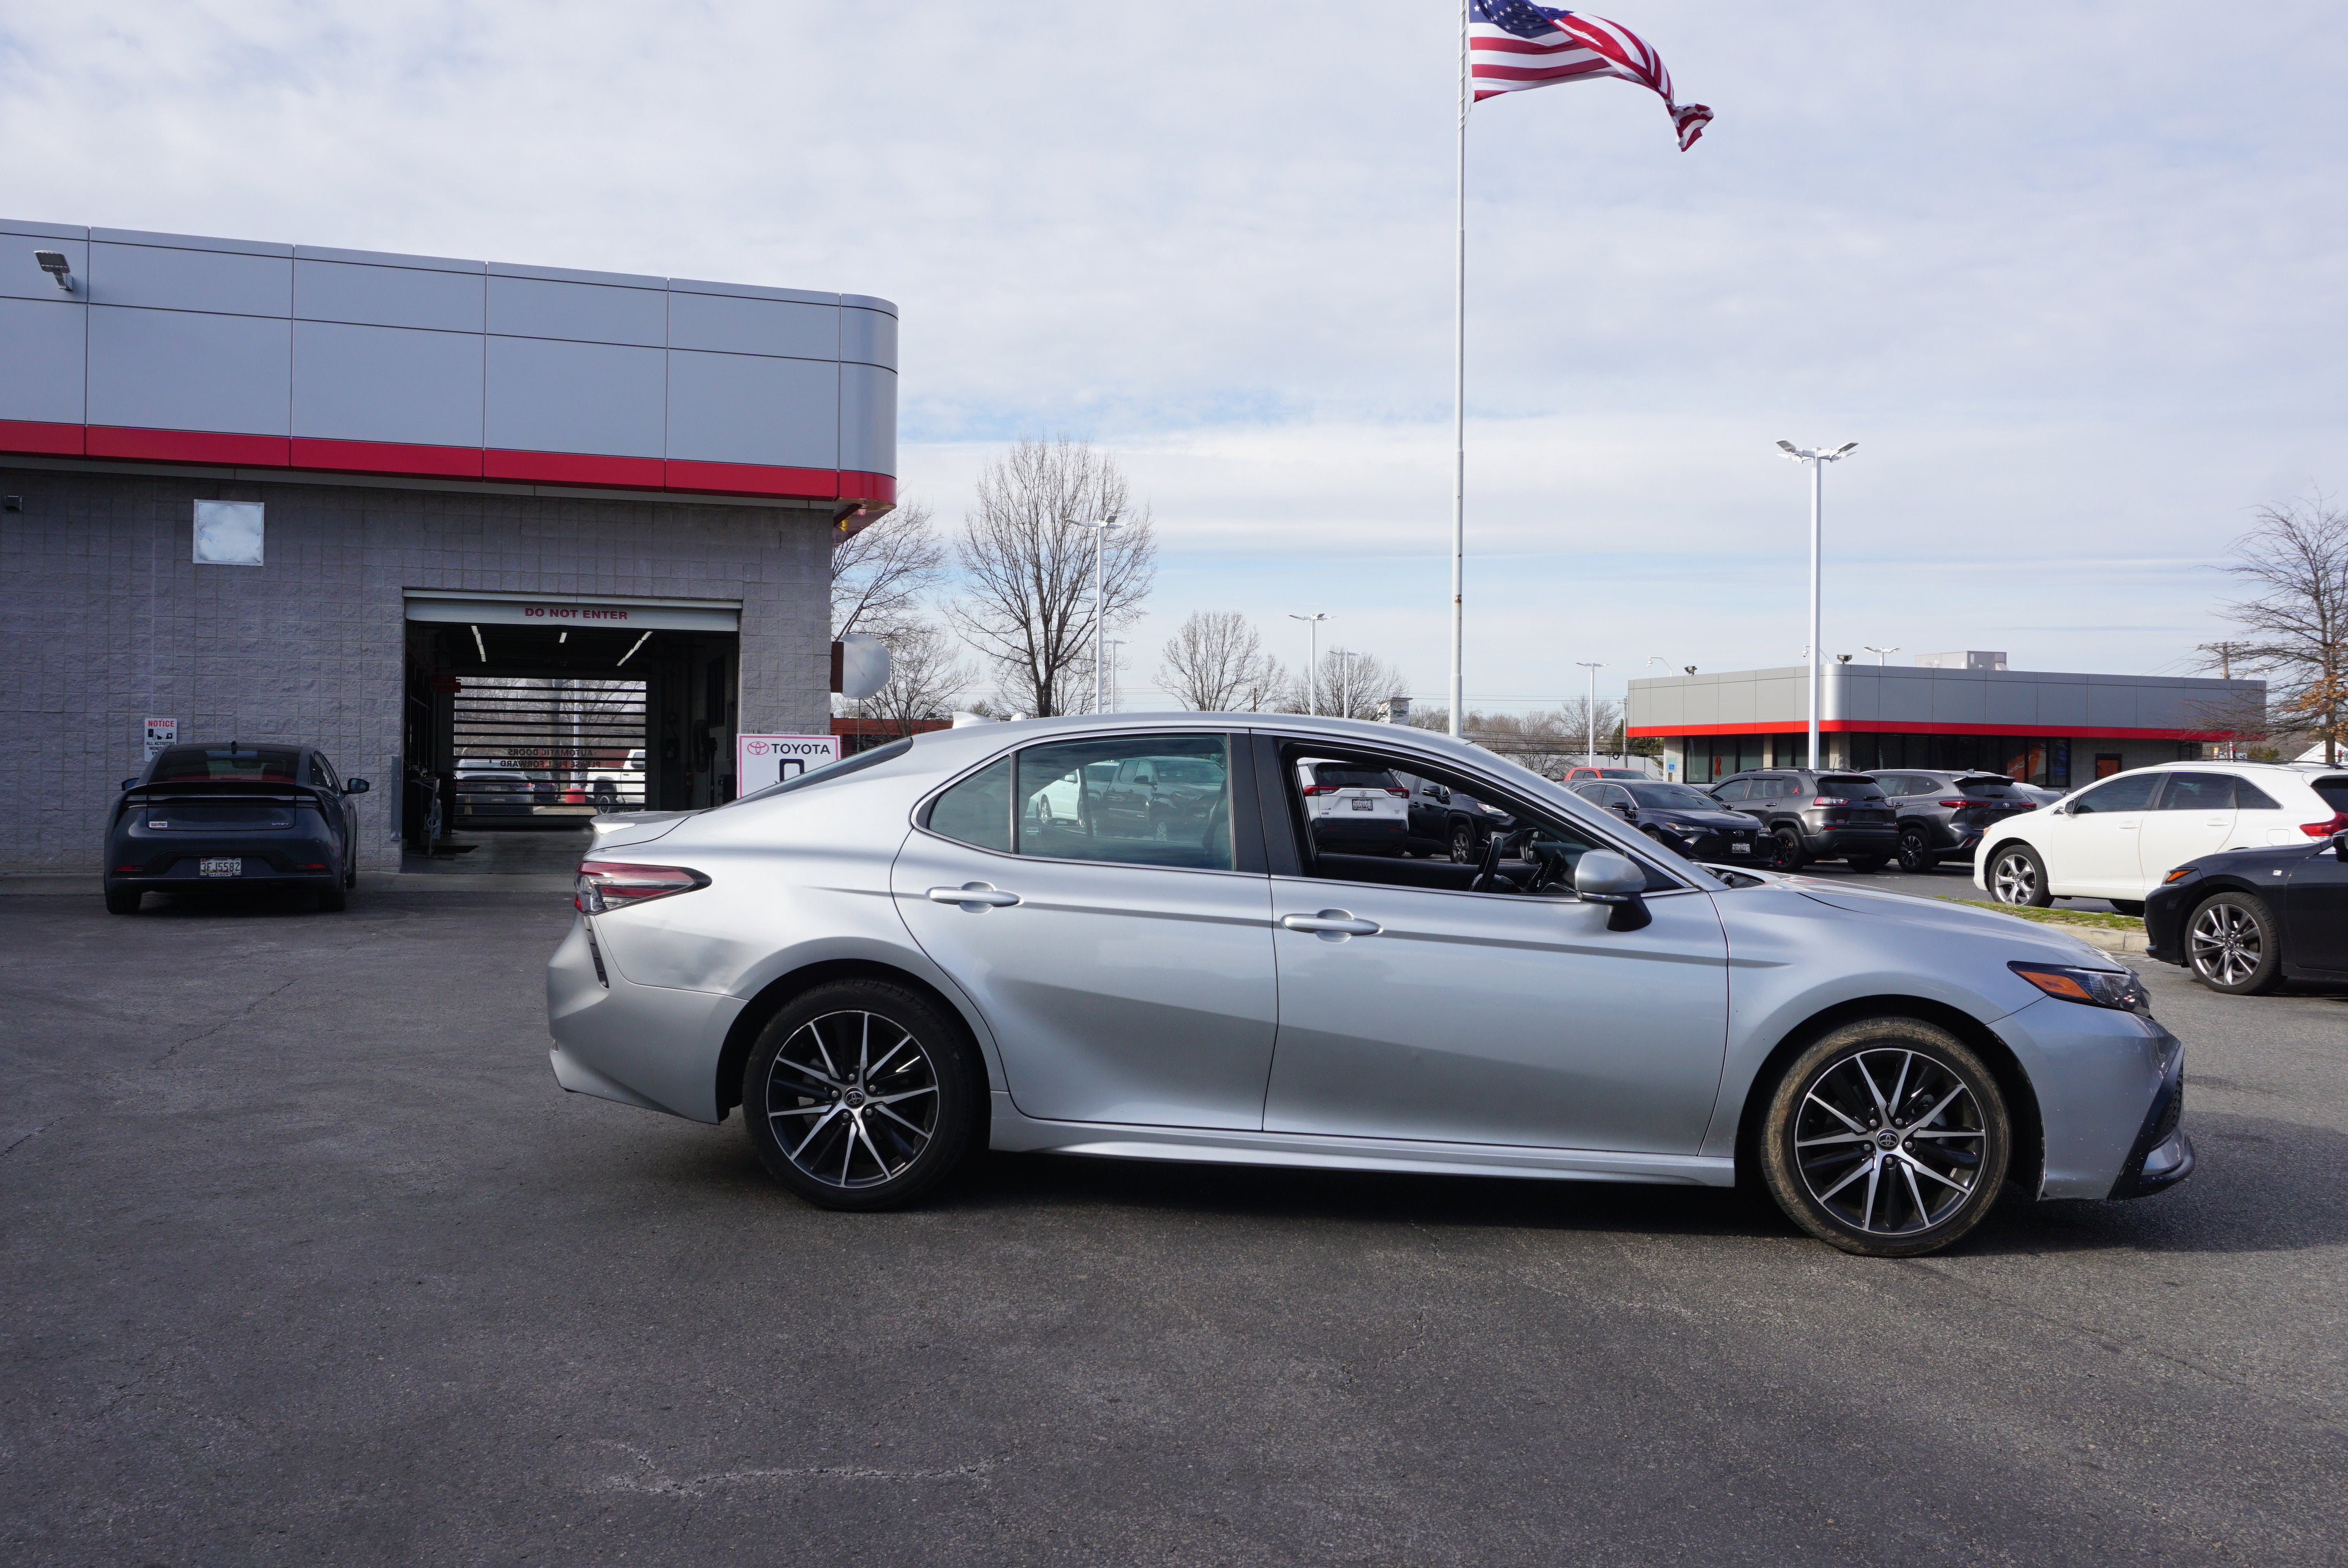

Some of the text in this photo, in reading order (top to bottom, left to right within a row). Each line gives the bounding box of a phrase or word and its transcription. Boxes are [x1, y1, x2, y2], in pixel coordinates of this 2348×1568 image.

[525, 608, 628, 620] DO NOT ENTER
[771, 743, 831, 755] TOYOTA
[201, 862, 240, 872] 3FJ5582
